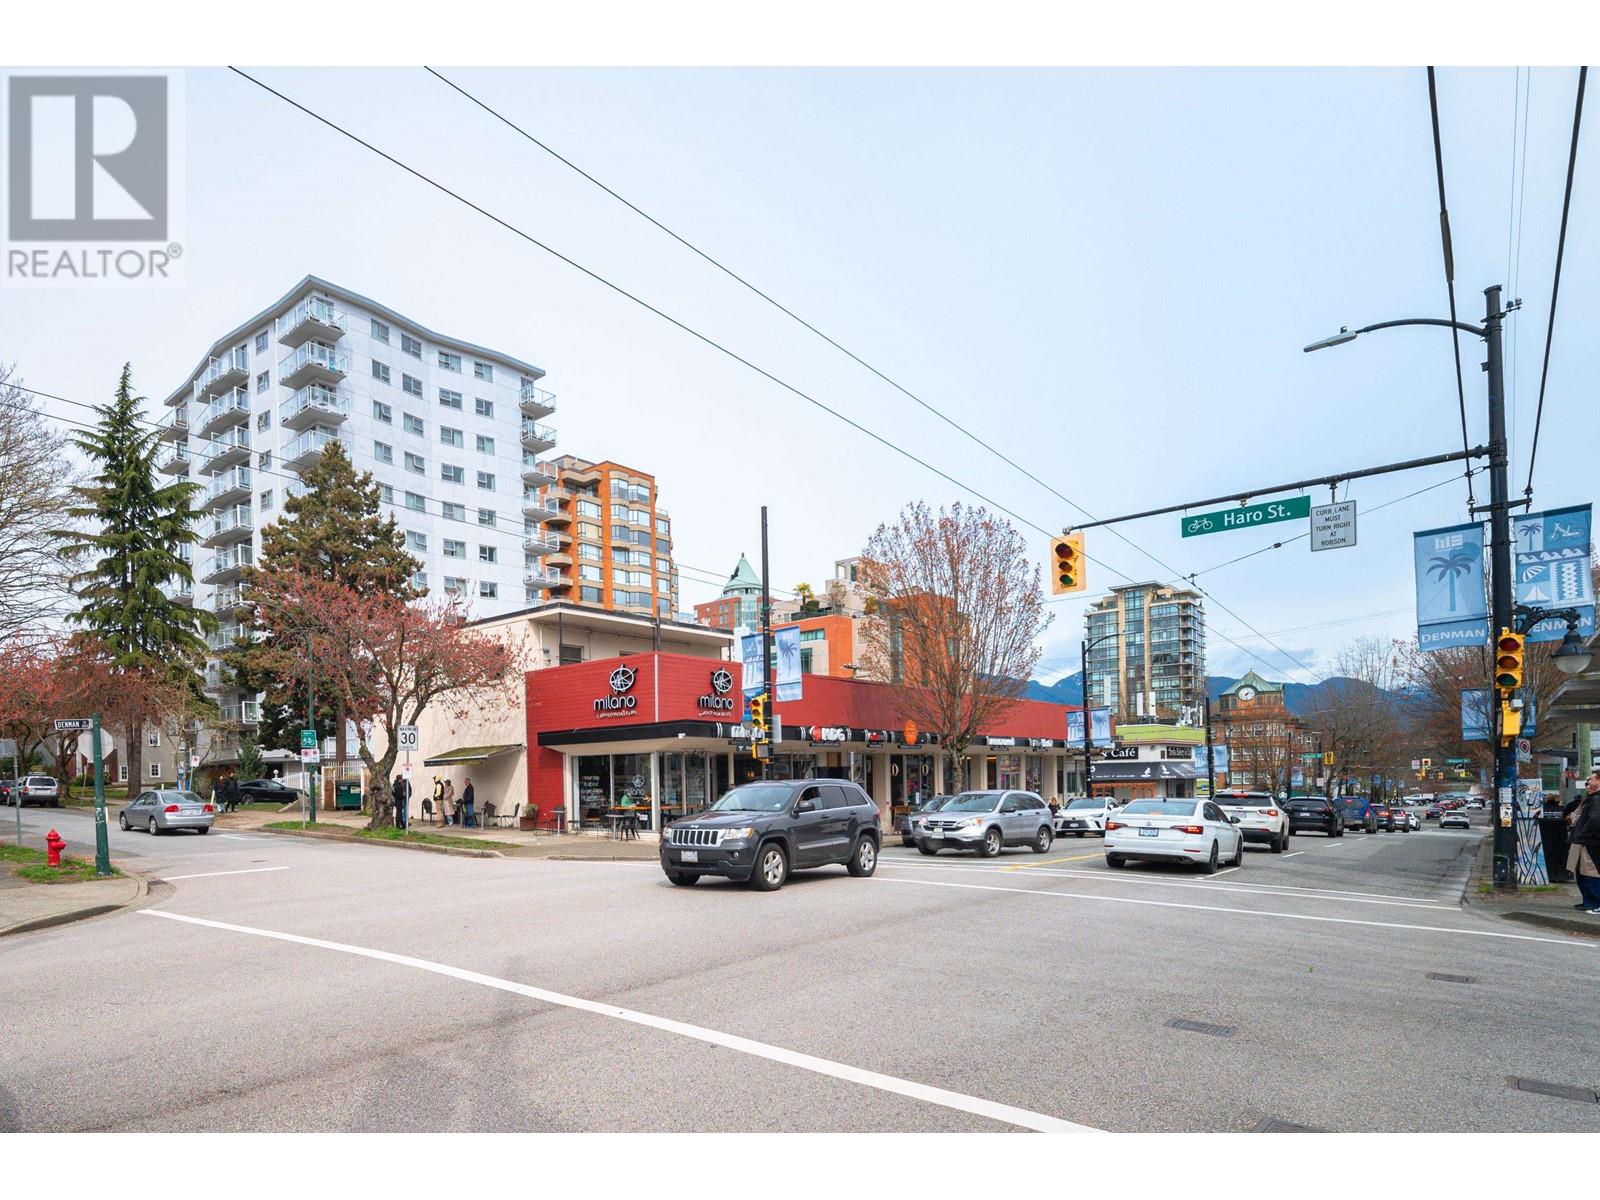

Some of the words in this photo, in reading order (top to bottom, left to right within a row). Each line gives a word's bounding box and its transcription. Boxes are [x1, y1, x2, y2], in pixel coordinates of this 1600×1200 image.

[1224, 510, 1263, 526] Haro
[1267, 504, 1291, 519] St.
[1335, 505, 1351, 513] LANE
[1316, 524, 1332, 532] TURN
[1333, 521, 1351, 529] RIGHT
[1321, 538, 1346, 546] ROBSON
[1421, 629, 1485, 643] DENMAN
[593, 694, 635, 710] milano
[700, 694, 734, 710] milano
[400, 732, 416, 745] 30
[1111, 746, 1136, 757] Café
